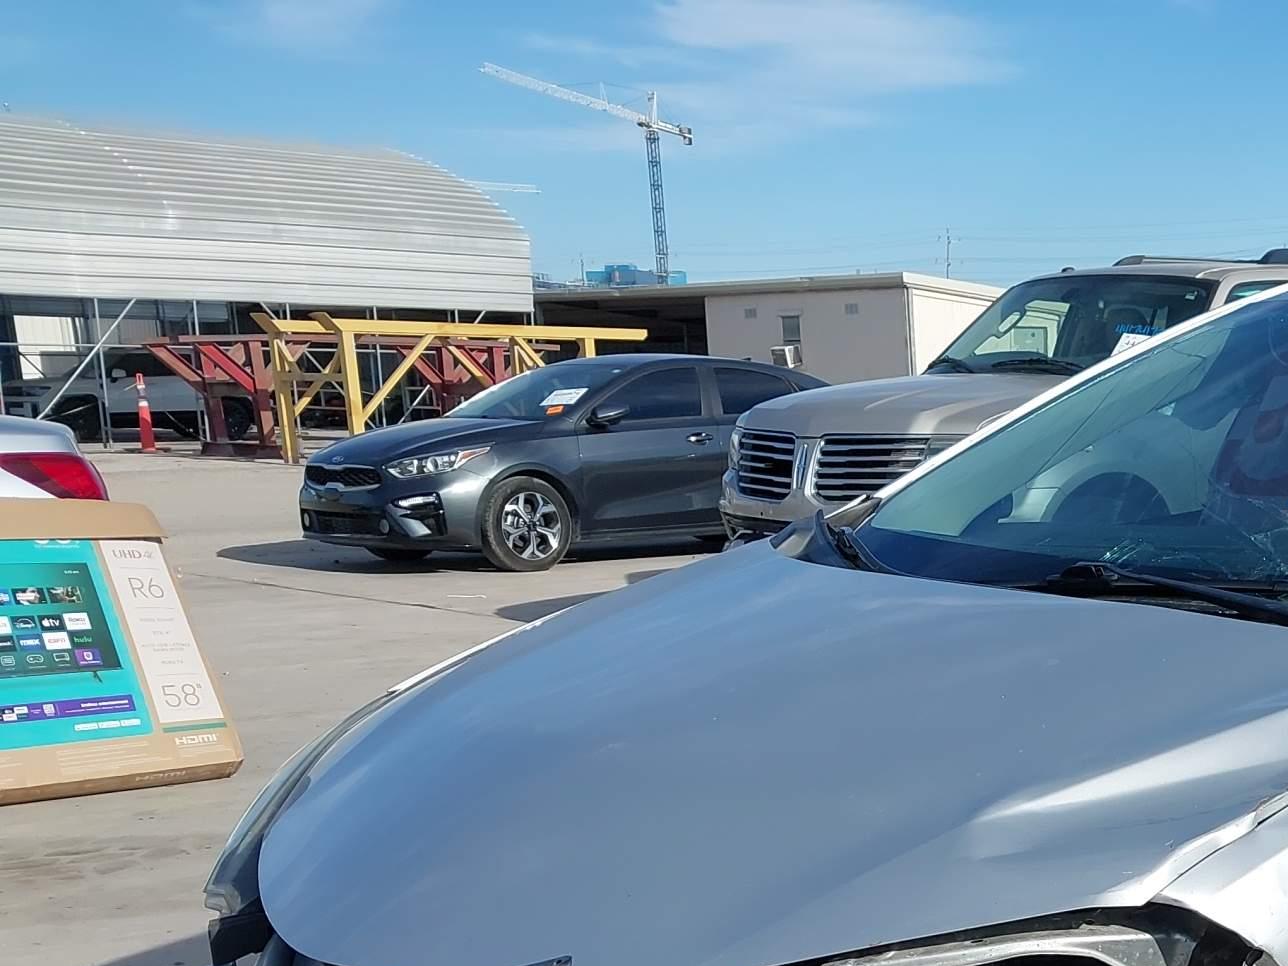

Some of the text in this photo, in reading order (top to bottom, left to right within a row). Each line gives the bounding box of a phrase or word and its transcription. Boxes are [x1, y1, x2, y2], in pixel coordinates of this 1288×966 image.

[112, 549, 142, 560] UHD
[128, 577, 165, 599] R6
[174, 733, 217, 746] HDMI
